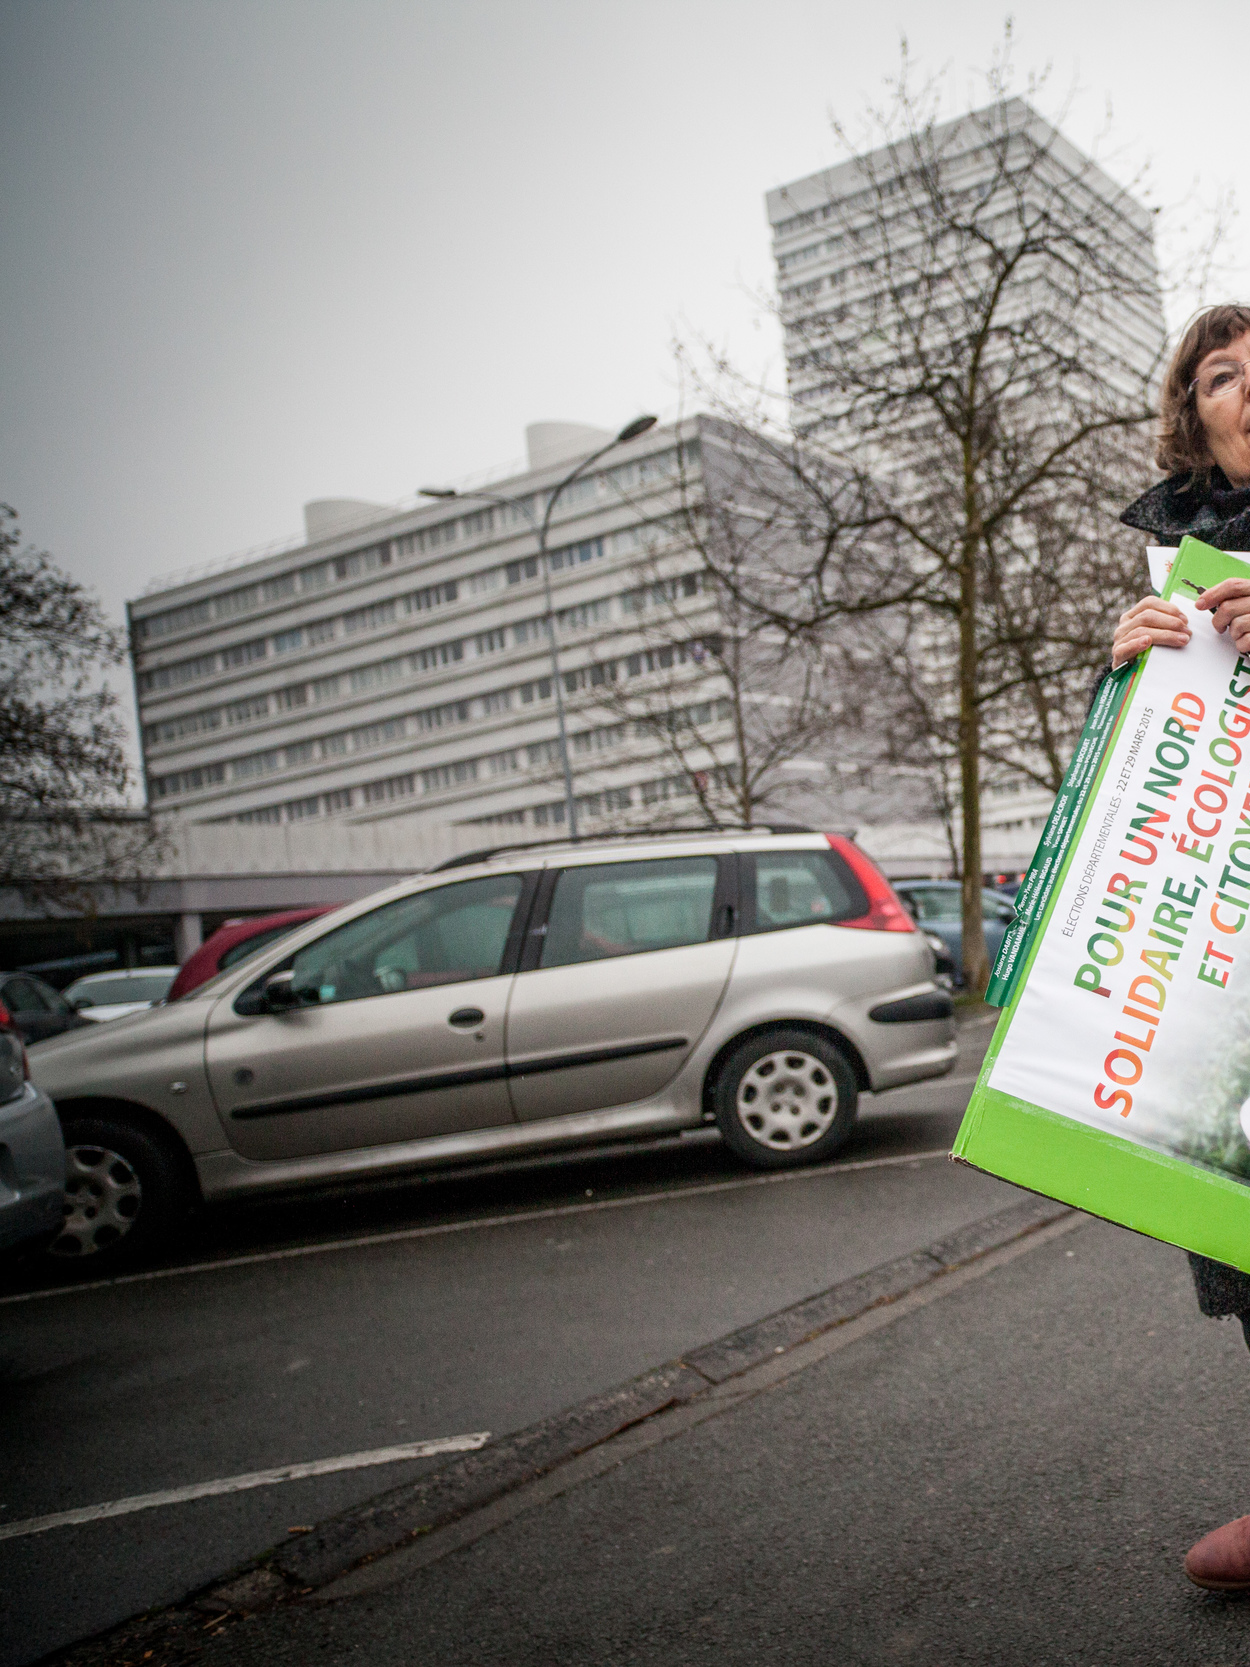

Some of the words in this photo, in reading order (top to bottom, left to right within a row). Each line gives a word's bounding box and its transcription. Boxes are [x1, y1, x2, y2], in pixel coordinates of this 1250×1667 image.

[1139, 707, 1153, 729] 2015
[1129, 729, 1146, 755] MARS
[1143, 692, 1205, 801] NORD
[1120, 767, 1131, 779] ET
[1125, 756, 1136, 768] 29
[1116, 780, 1128, 792] 22
[1034, 911, 1042, 920] Les
[1039, 884, 1052, 911] candidats
[1051, 849, 1064, 874] élections
[1061, 804, 1081, 849] départementales
[1079, 789, 1086, 797] 22
[1092, 751, 1100, 764] 2015
[1043, 825, 1057, 847] Sylviane
[1052, 794, 1068, 825] DELACROIX
[1119, 802, 1170, 865] UN
[1082, 796, 1121, 884] DÉPARTEMENTALES
[1029, 869, 1038, 882] PIRA
[1039, 857, 1052, 879] RIGAUD
[1061, 884, 1089, 937] ÉLECTIONS
[1074, 873, 1147, 998] POUR
[994, 954, 1006, 978] Josiane
[1002, 964, 1013, 980] Hugo
[1197, 940, 1233, 989] ET
[1094, 875, 1208, 1118] SOLIDAIRE,
